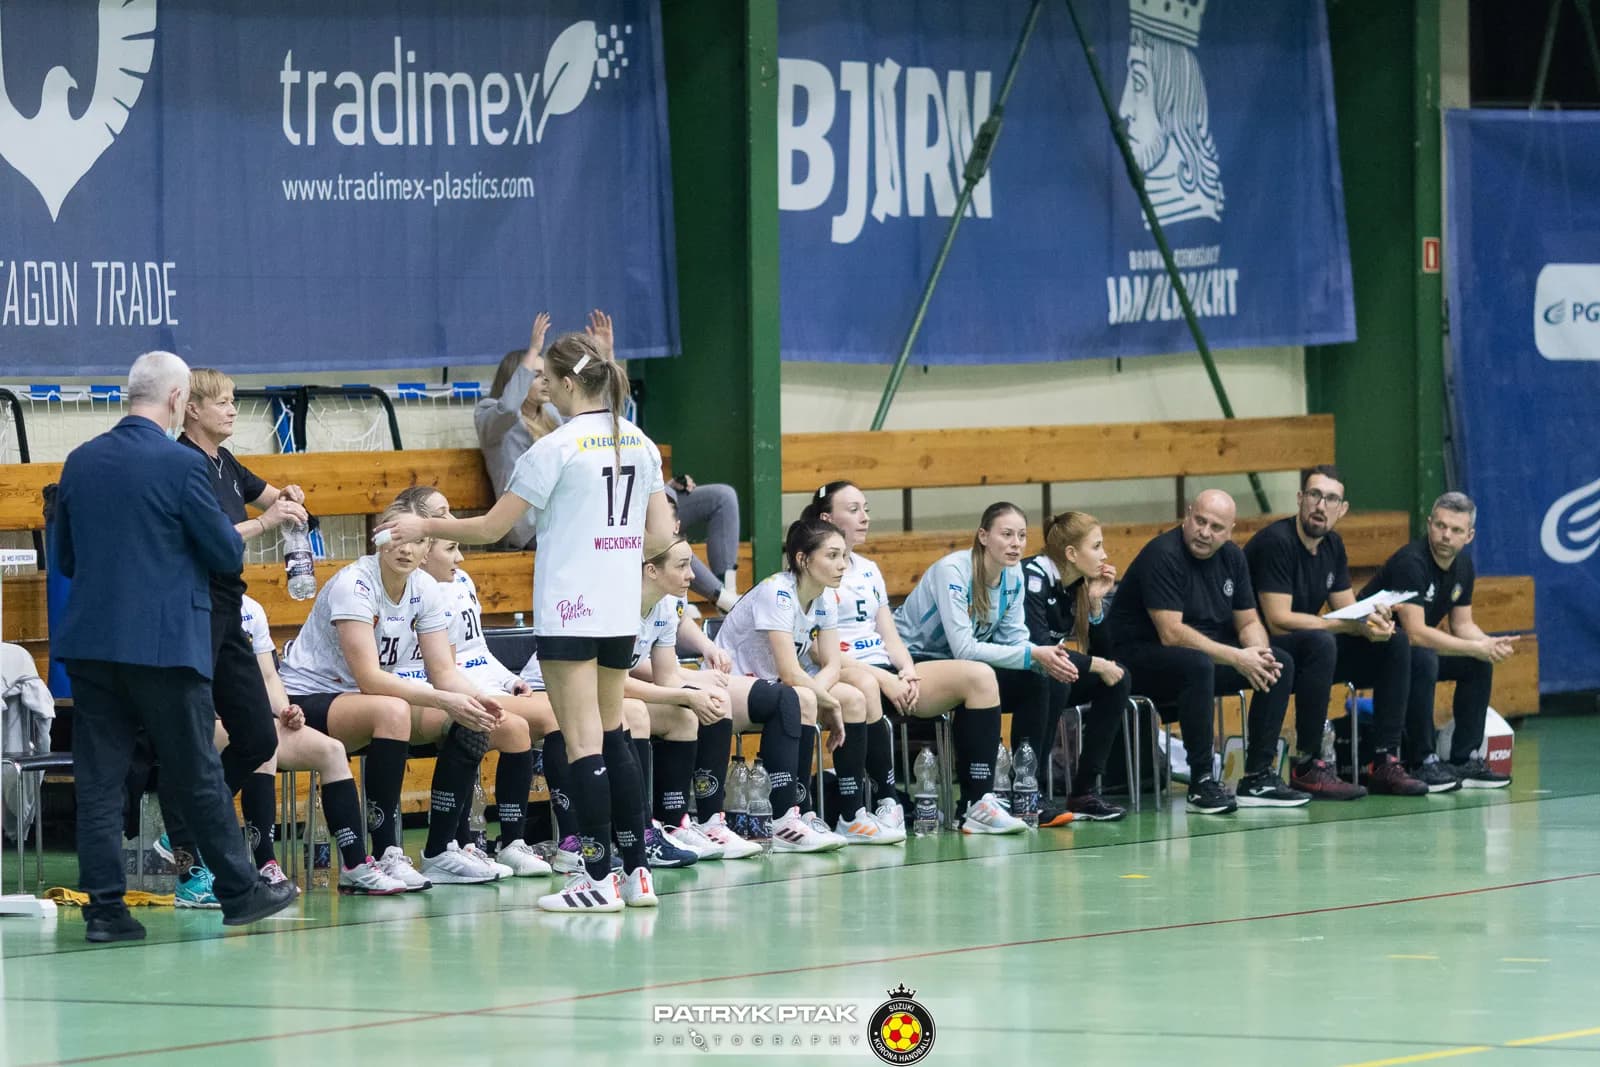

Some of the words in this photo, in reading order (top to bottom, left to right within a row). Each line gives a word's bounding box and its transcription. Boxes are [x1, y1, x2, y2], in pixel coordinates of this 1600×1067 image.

[280, 36, 540, 146] tradimex
[777, 57, 993, 244] BJØRN
[282, 171, 535, 206] www.tradimex-plastics.com
[0, 260, 78, 326] AGON
[92, 261, 179, 325] TRADE
[597, 435, 641, 447] LEWATAN
[602, 465, 635, 527] 17
[461, 608, 480, 640] 31
[855, 599, 868, 622] 5
